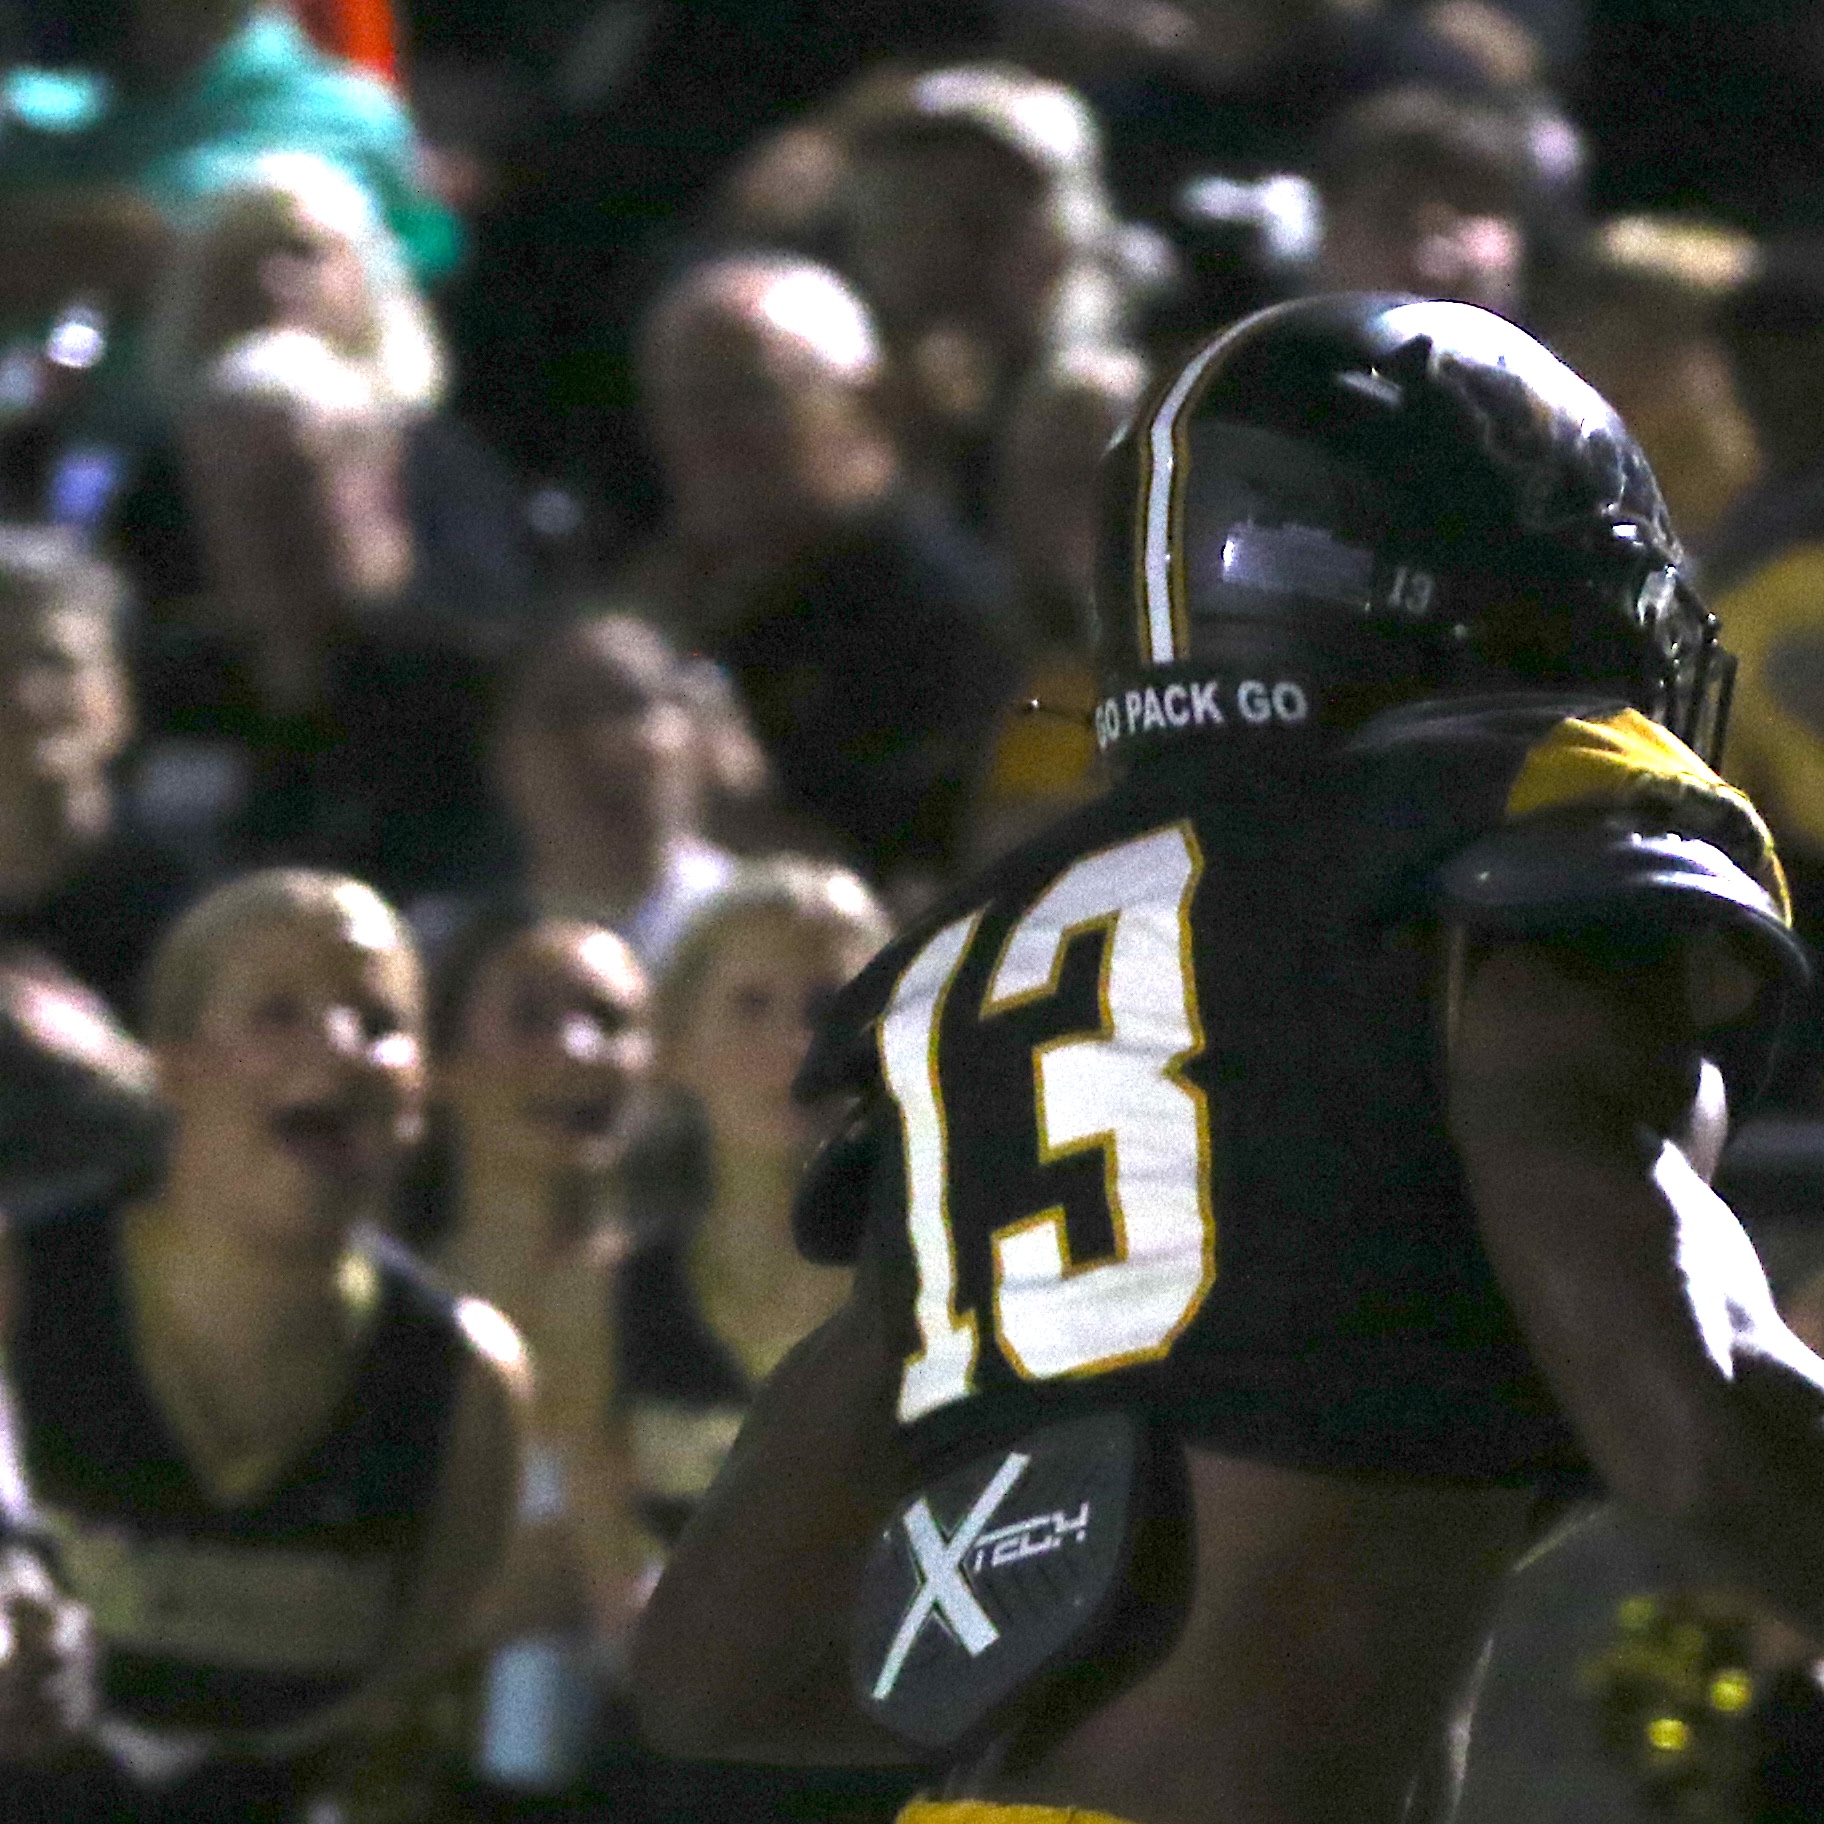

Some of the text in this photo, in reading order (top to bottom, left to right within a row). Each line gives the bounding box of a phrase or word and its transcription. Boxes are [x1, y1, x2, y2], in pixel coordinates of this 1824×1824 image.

[1125, 680, 1225, 736] PACK
[1237, 679, 1309, 725] GO
[876, 817, 1218, 1426] 13
